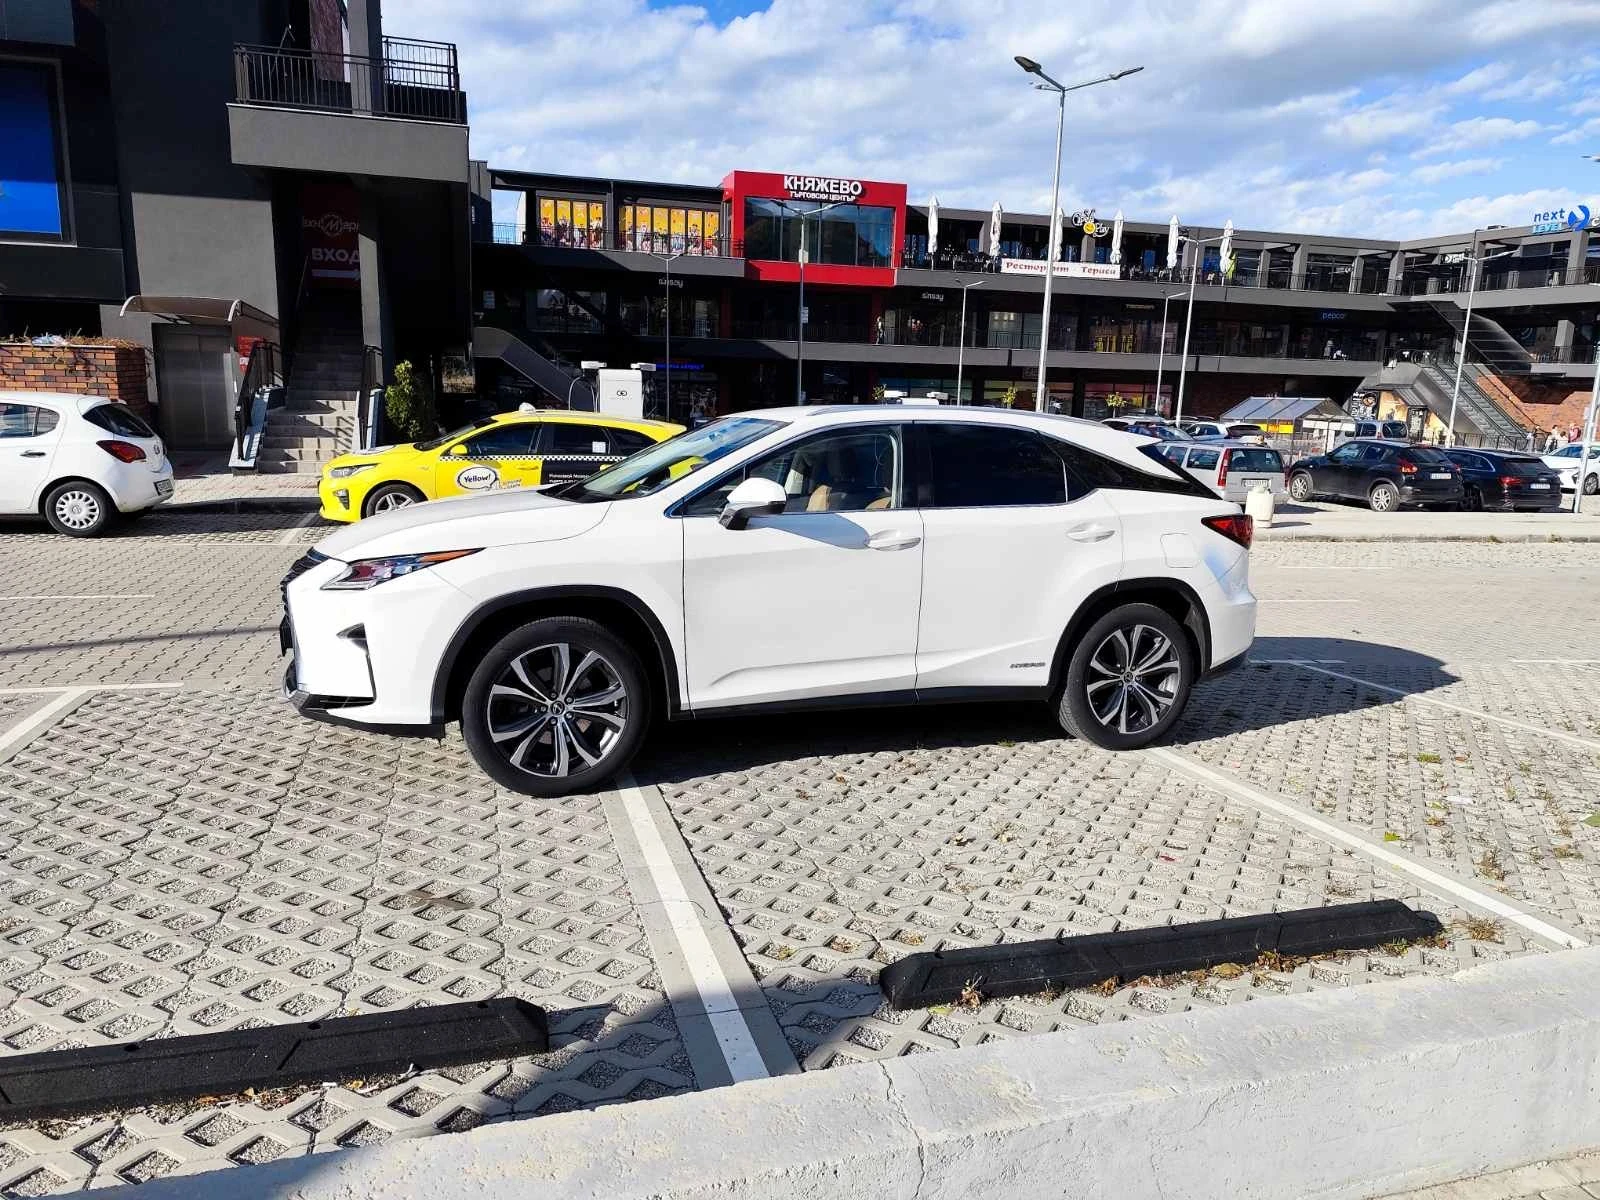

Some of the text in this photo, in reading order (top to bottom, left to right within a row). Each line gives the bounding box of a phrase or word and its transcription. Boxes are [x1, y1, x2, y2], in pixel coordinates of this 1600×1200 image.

[783, 176, 862, 195] КНЯЖЕВО
[789, 190, 857, 202] ТЪРГОВСКИ ЦЕНТЪР
[1533, 208, 1565, 222] next
[1532, 222, 1563, 234] LEVEL
[311, 247, 360, 264] ВХОД
[1006, 262, 1069, 273] Ресторнт
[464, 474, 491, 483] Yellow!
